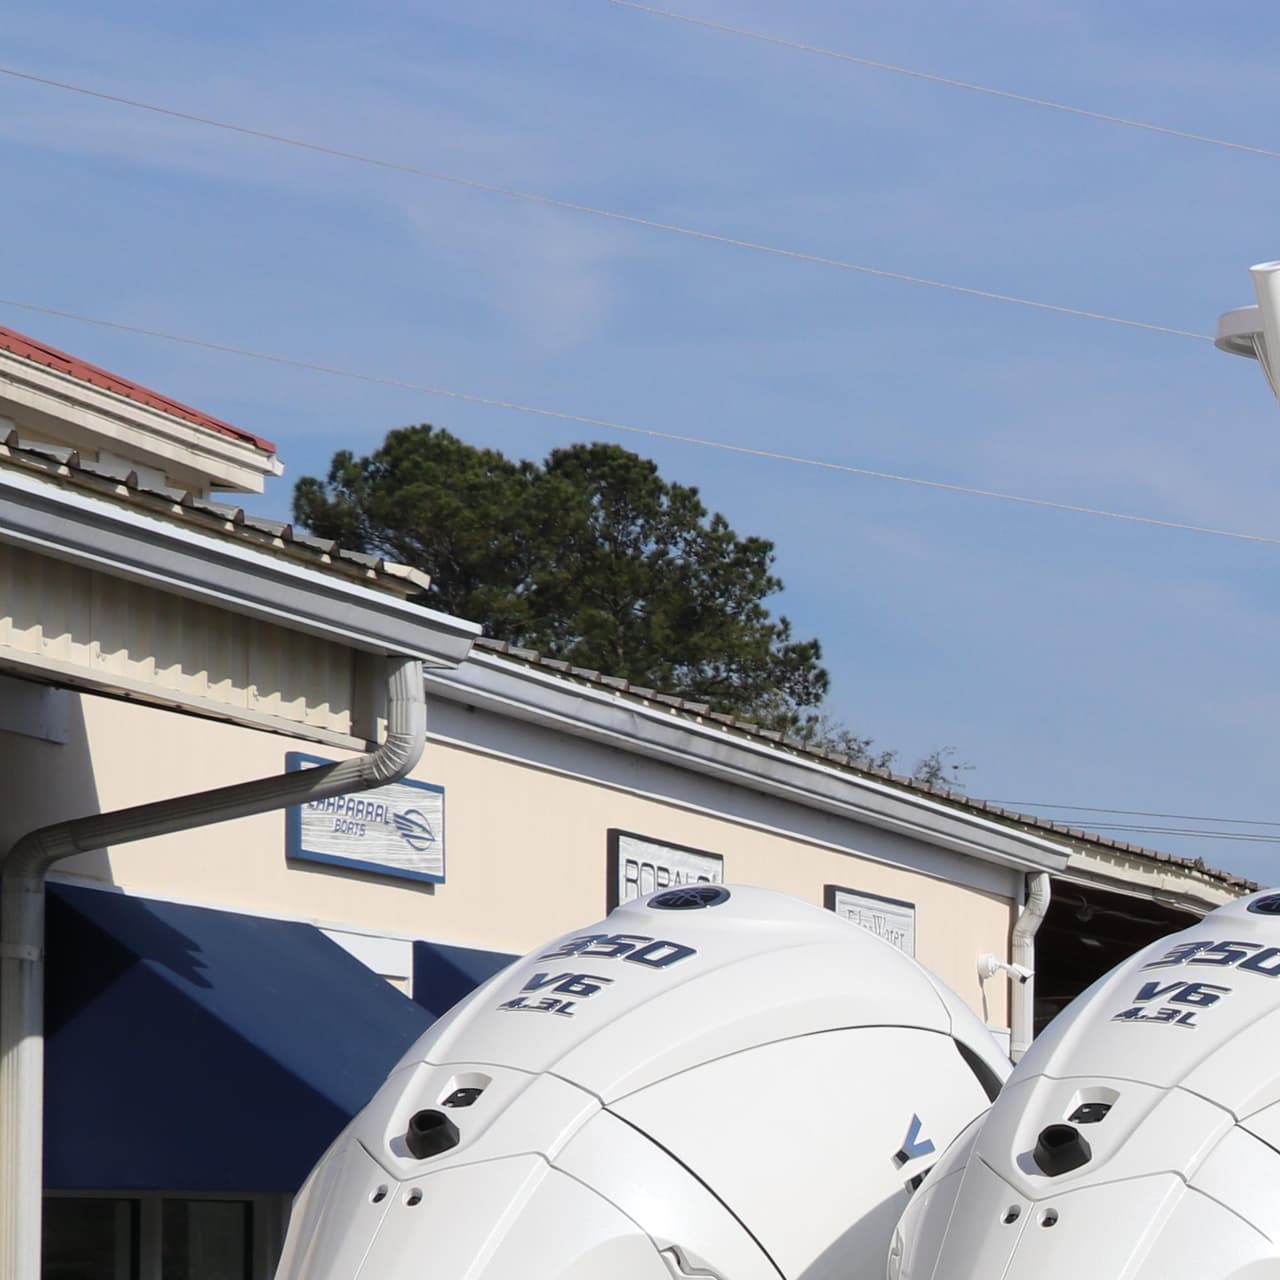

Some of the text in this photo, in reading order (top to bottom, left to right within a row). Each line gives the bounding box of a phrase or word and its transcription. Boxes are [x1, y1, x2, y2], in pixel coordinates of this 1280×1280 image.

[334, 818, 367, 837] BOATS
[534, 933, 698, 970] 350
[519, 972, 615, 998] V6
[1132, 981, 1233, 1009] V6
[496, 996, 577, 1018] 4.3L
[1110, 1006, 1198, 1030] 4.3L
